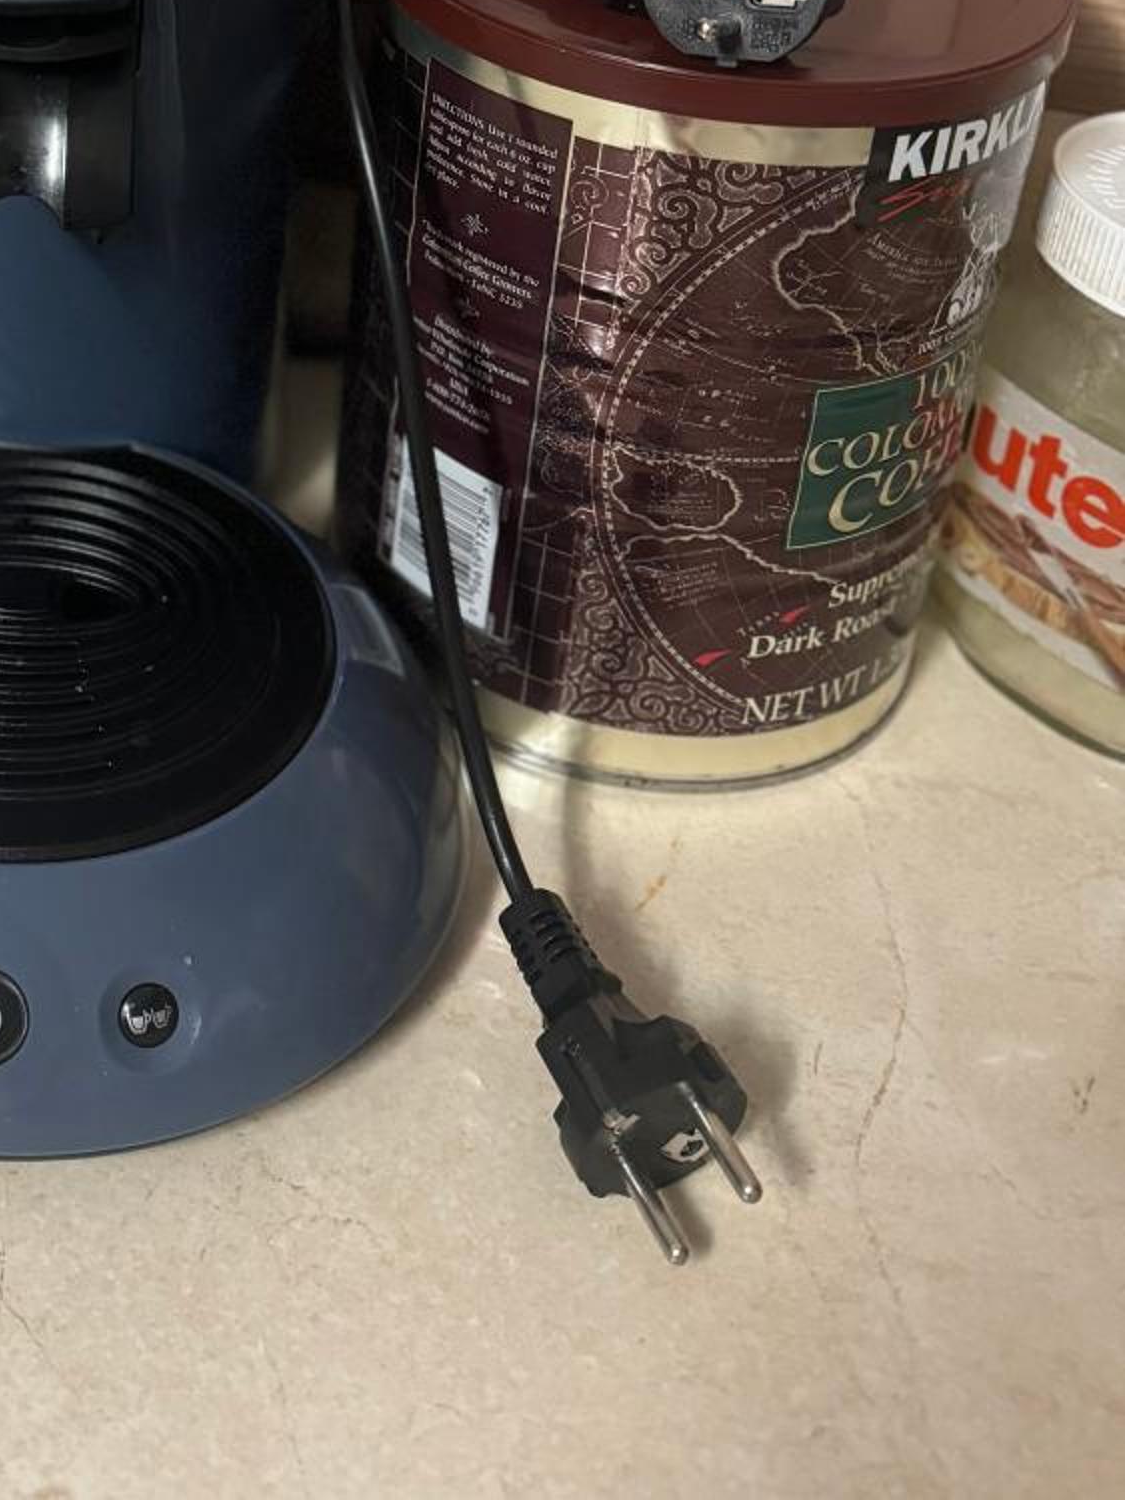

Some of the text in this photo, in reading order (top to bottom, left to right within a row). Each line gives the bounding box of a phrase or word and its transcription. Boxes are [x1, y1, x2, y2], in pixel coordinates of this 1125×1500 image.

[963, 399, 1125, 550] ute
[746, 625, 828, 660] Dark
[741, 689, 816, 725] NET
[818, 666, 869, 709] WT
